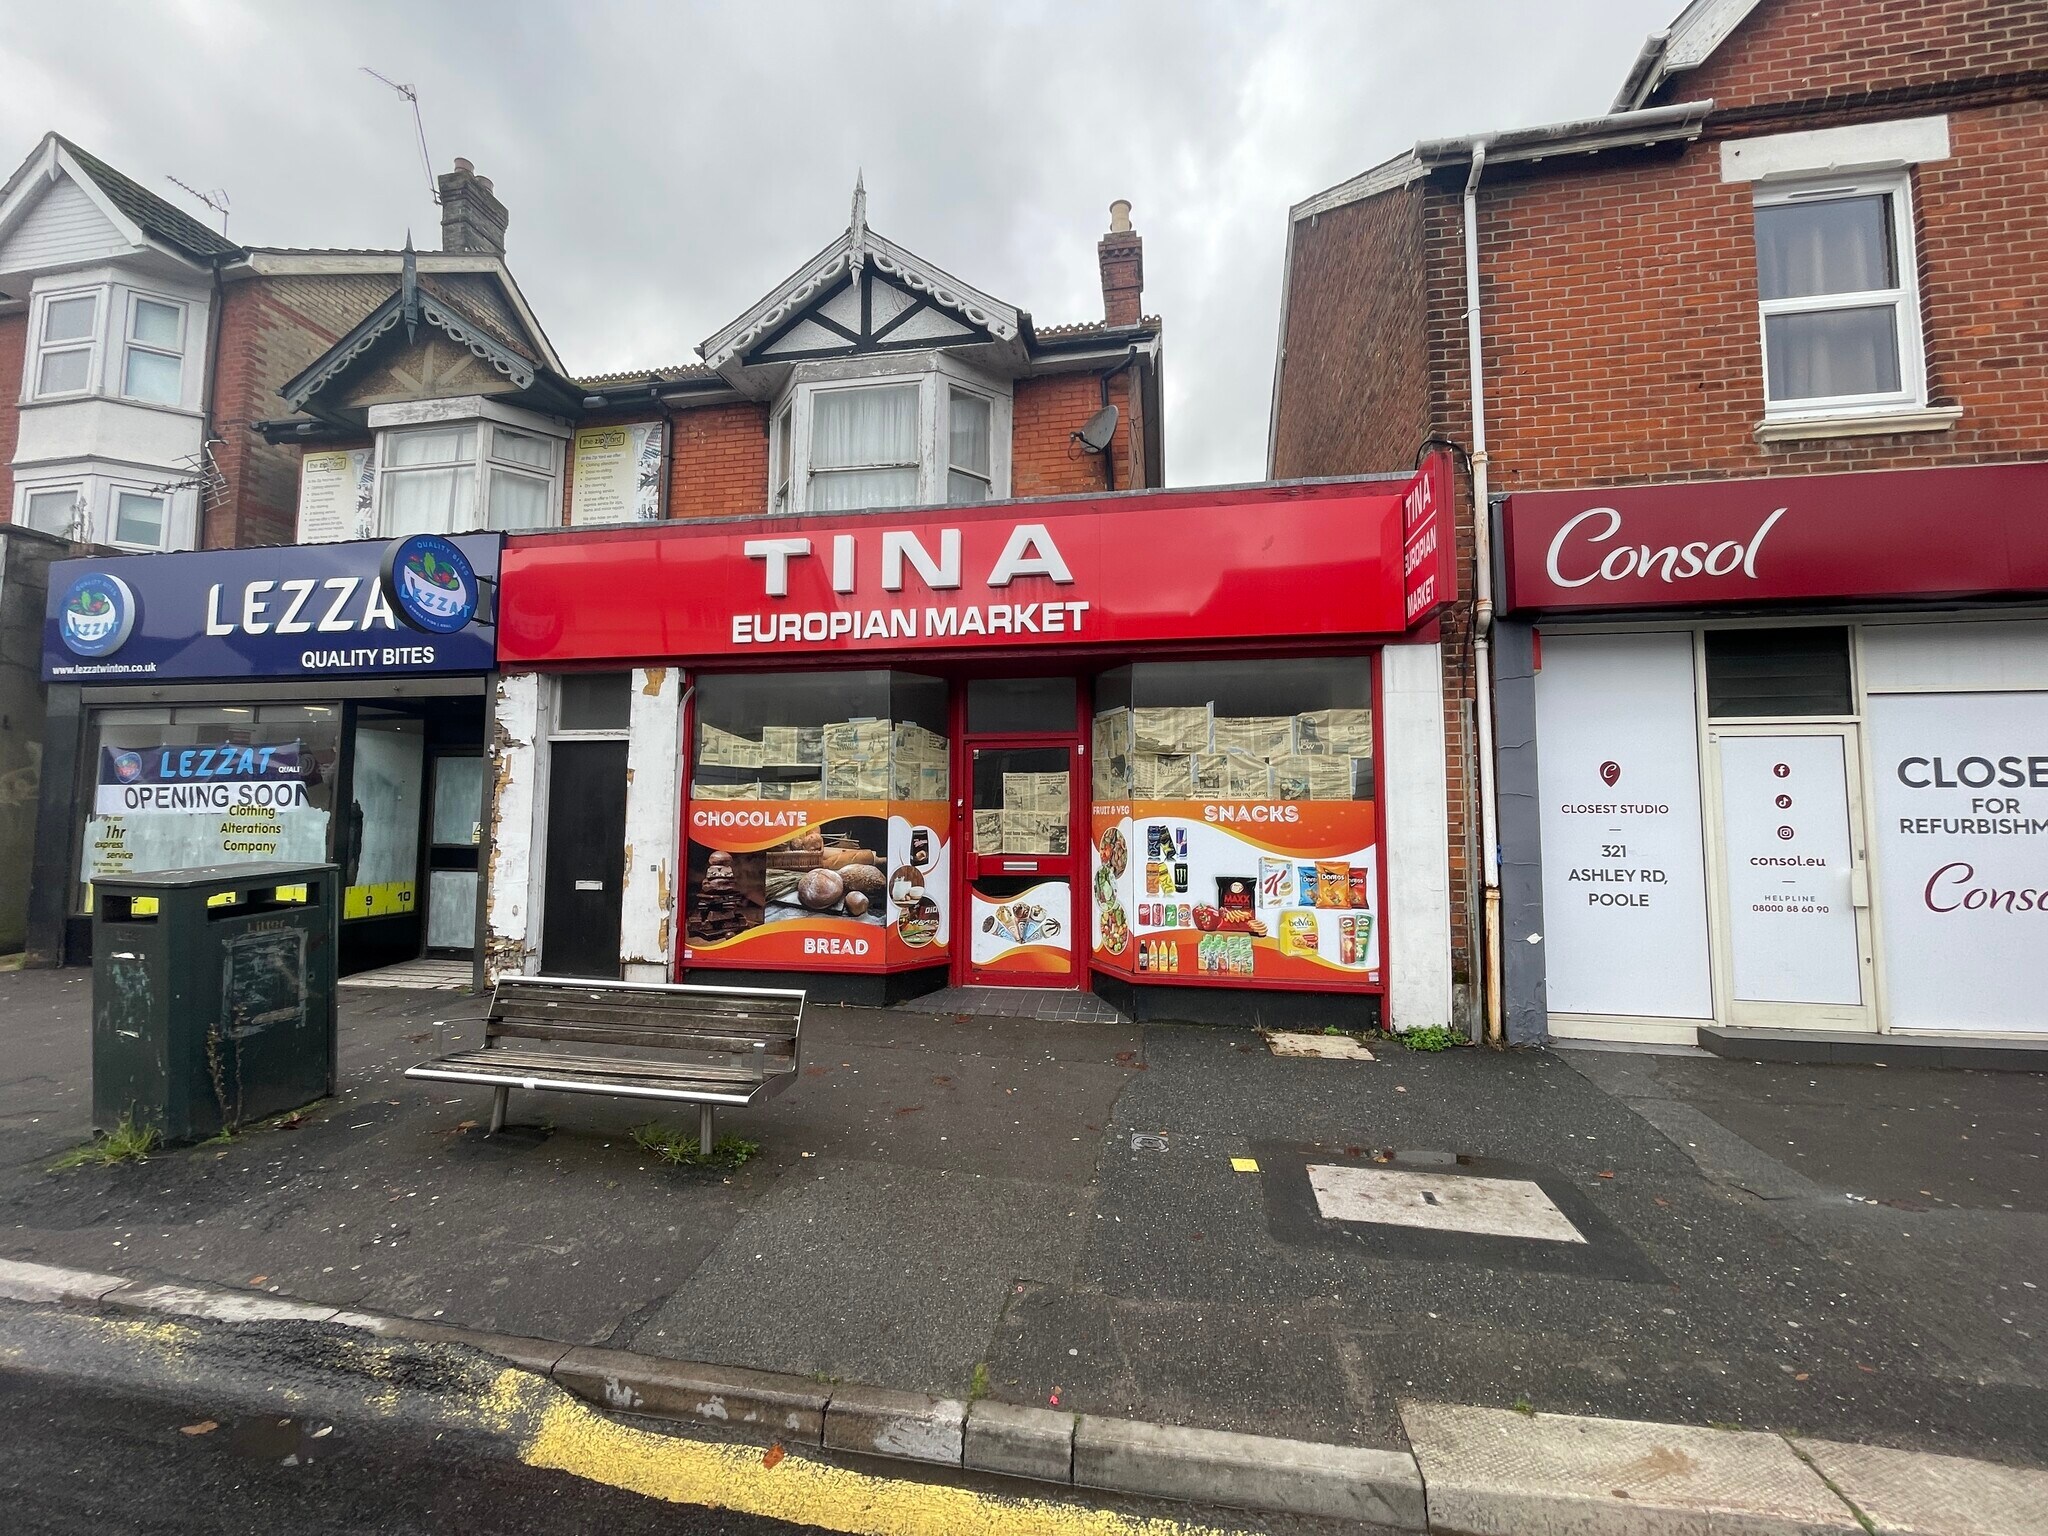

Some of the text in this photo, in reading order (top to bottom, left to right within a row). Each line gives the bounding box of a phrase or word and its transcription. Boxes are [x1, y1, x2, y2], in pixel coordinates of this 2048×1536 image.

[1405, 472, 1431, 528] TINA
[1546, 507, 1788, 588] Consol
[744, 523, 1074, 597] TINA
[401, 584, 470, 617] LEZZAT
[1407, 575, 1434, 619] MARKET
[731, 601, 1090, 644] EUROPIAN MARKET
[302, 646, 435, 669] QUALITY BITES
[52, 662, 157, 675] www.lezzatwinton.co.uk
[160, 747, 277, 778] LEZZAT
[1897, 756, 2048, 789] CLOSE
[124, 784, 229, 810] OPENING
[229, 805, 276, 819] Clothing
[1093, 805, 1110, 815] FRUIT
[1116, 805, 1130, 815] VEG
[1561, 804, 1669, 814] CLOSEST STUDIO
[1972, 798, 2021, 814] FOR
[693, 811, 807, 827] CHOCOLATE
[1204, 805, 1299, 823] SNACKS
[220, 822, 281, 834] Alterations
[95, 841, 124, 850] express
[223, 840, 276, 854] Company
[1601, 845, 1627, 858] 321
[106, 851, 134, 859] service
[1750, 855, 1826, 867] consol.eu
[1321, 873, 1345, 881] Doritos
[1568, 869, 1668, 885] ASHLEY RD,
[366, 895, 373, 906] 9
[398, 891, 411, 901] 10
[1224, 894, 1250, 903] MAXX
[1588, 893, 1650, 907] POOLE
[1752, 904, 1829, 914] 08000 88 60 90
[1288, 916, 1315, 927] belVita
[804, 938, 869, 955] BREAD
